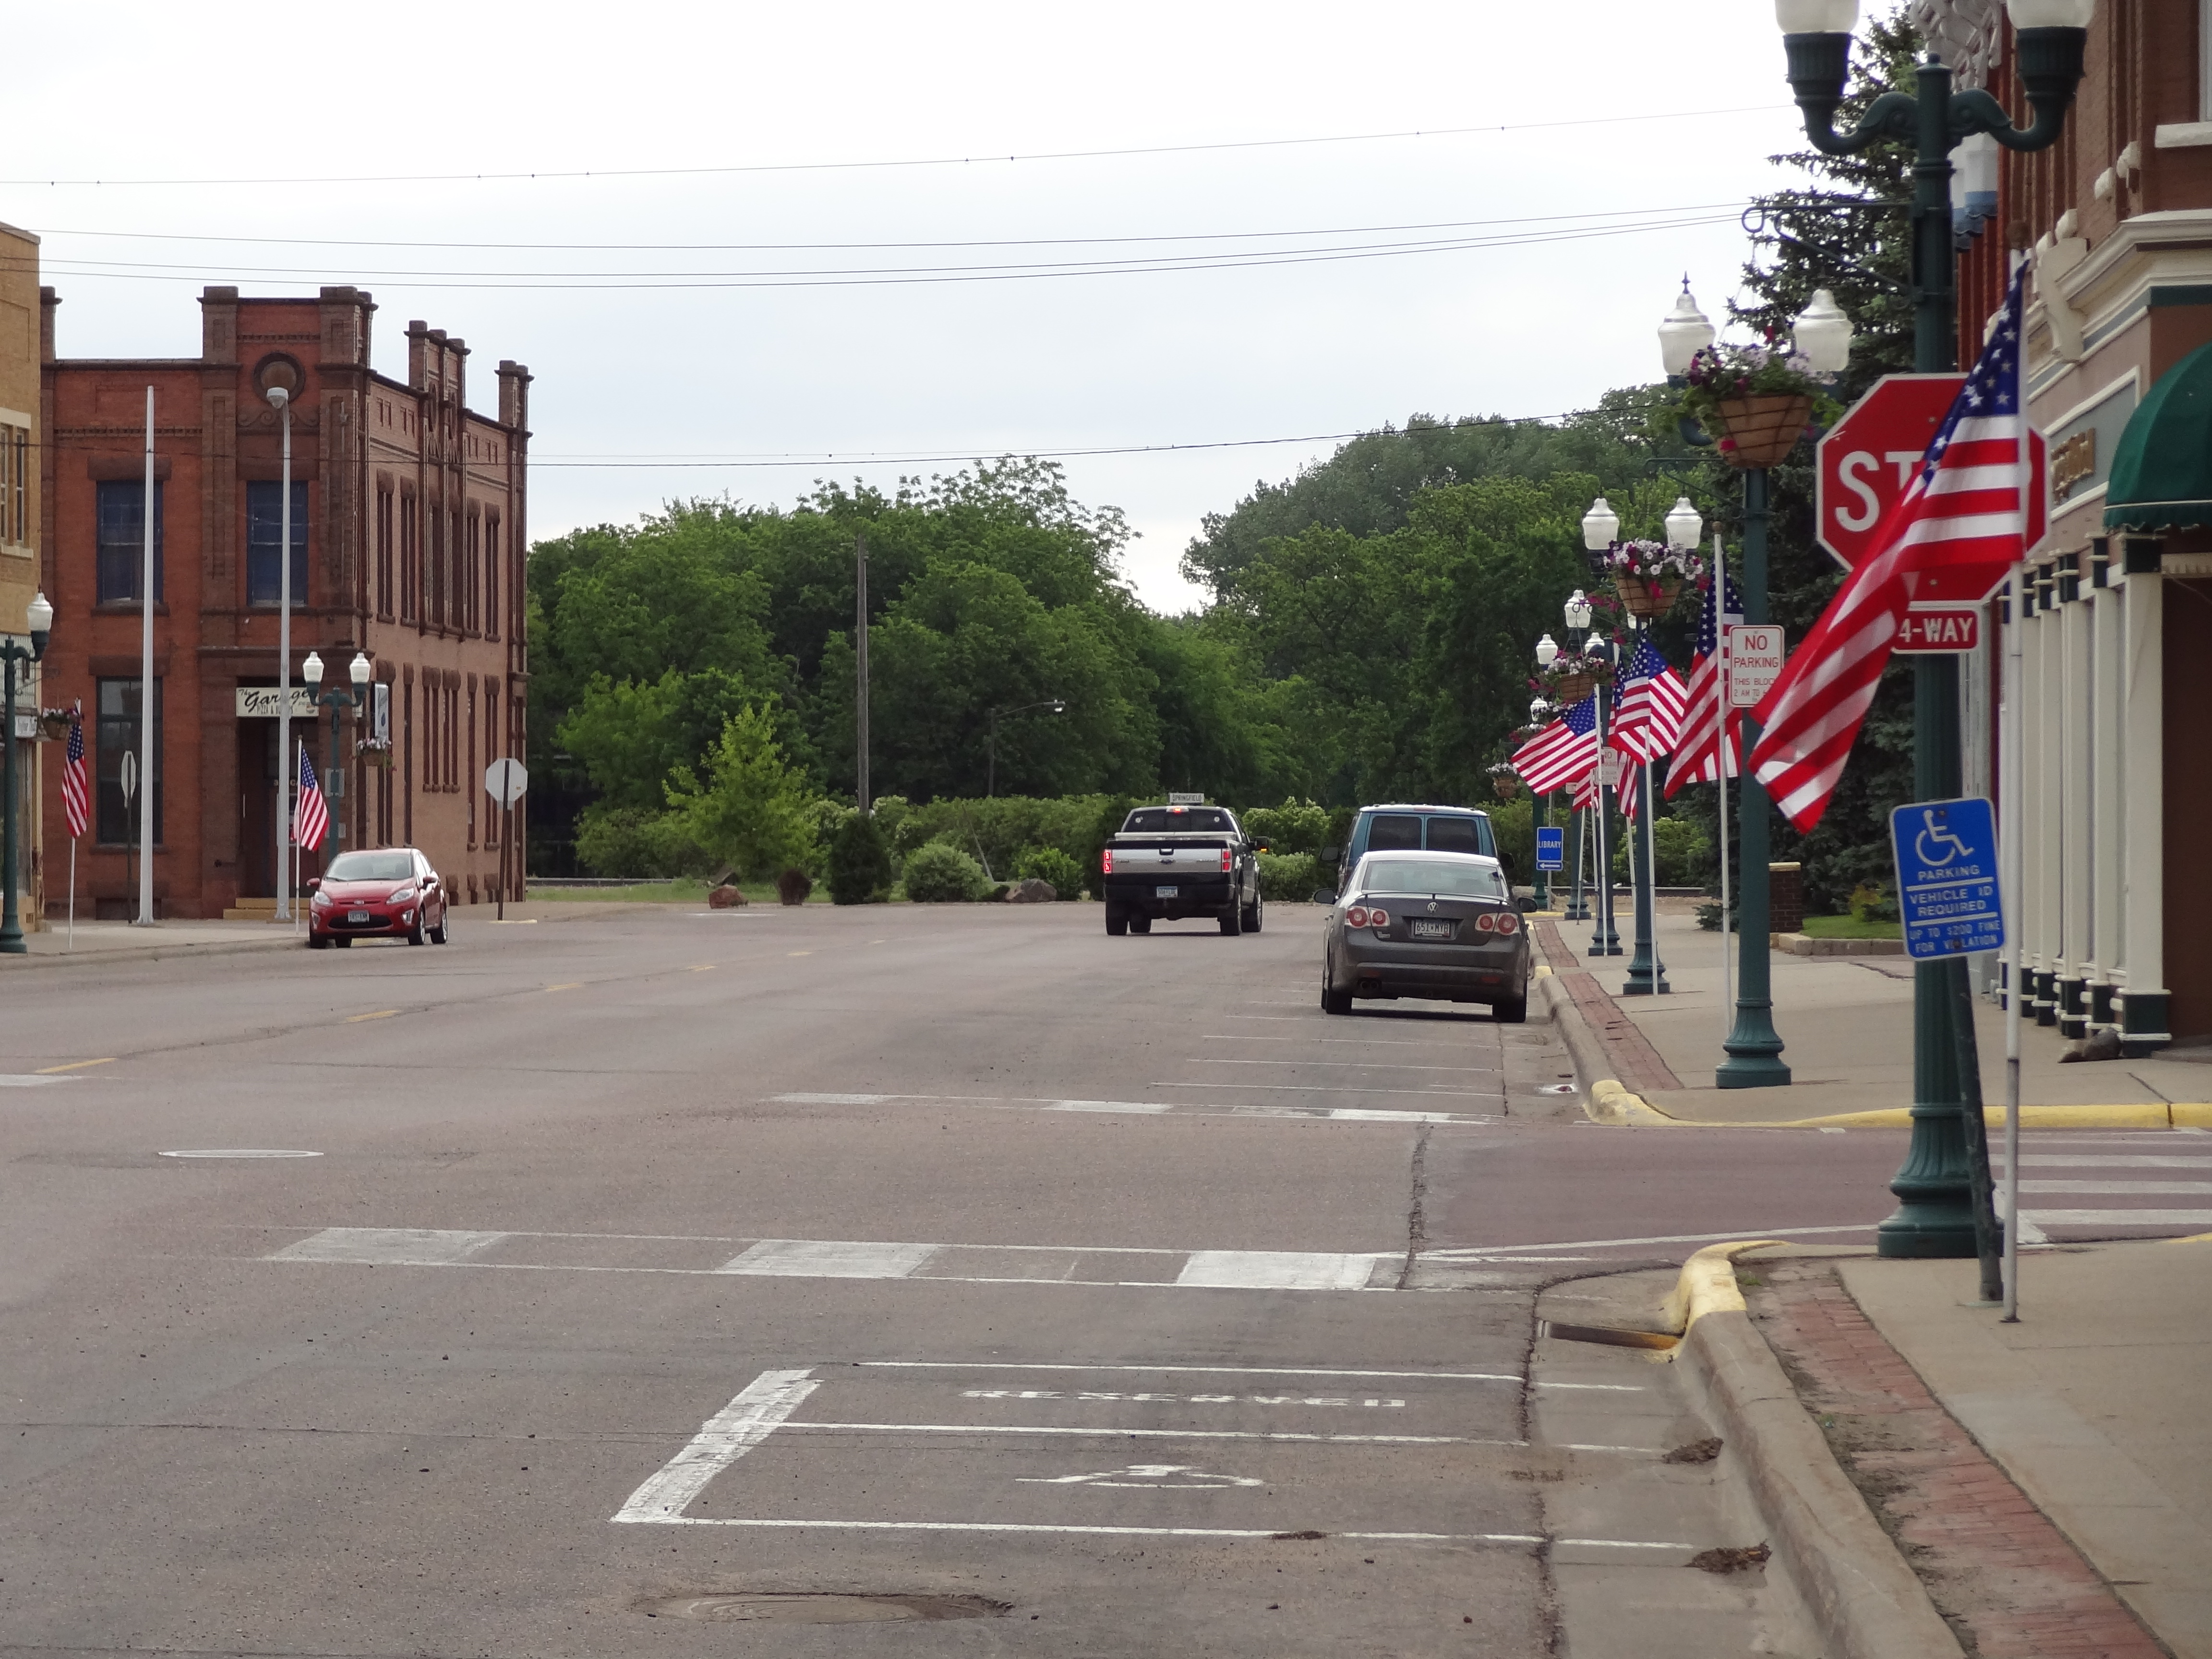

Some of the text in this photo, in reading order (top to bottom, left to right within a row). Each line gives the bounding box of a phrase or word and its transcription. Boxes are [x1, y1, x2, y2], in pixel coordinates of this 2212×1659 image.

[1899, 617, 1973, 642] 4-WAY
[1745, 635, 1767, 650] NO
[1734, 657, 1778, 668] PARKING
[244, 690, 309, 713] Garge
[1918, 865, 1980, 881] PARKING
[1909, 886, 1993, 904] VEHICLE ID
[1917, 900, 1986, 916] REQUIRED
[1909, 929, 1923, 940] UP
[1928, 927, 1940, 938] TO
[1978, 920, 2000, 932] FINE
[1915, 934, 1997, 953] FOR VILATION
[959, 1390, 1406, 1407] RESERVED
